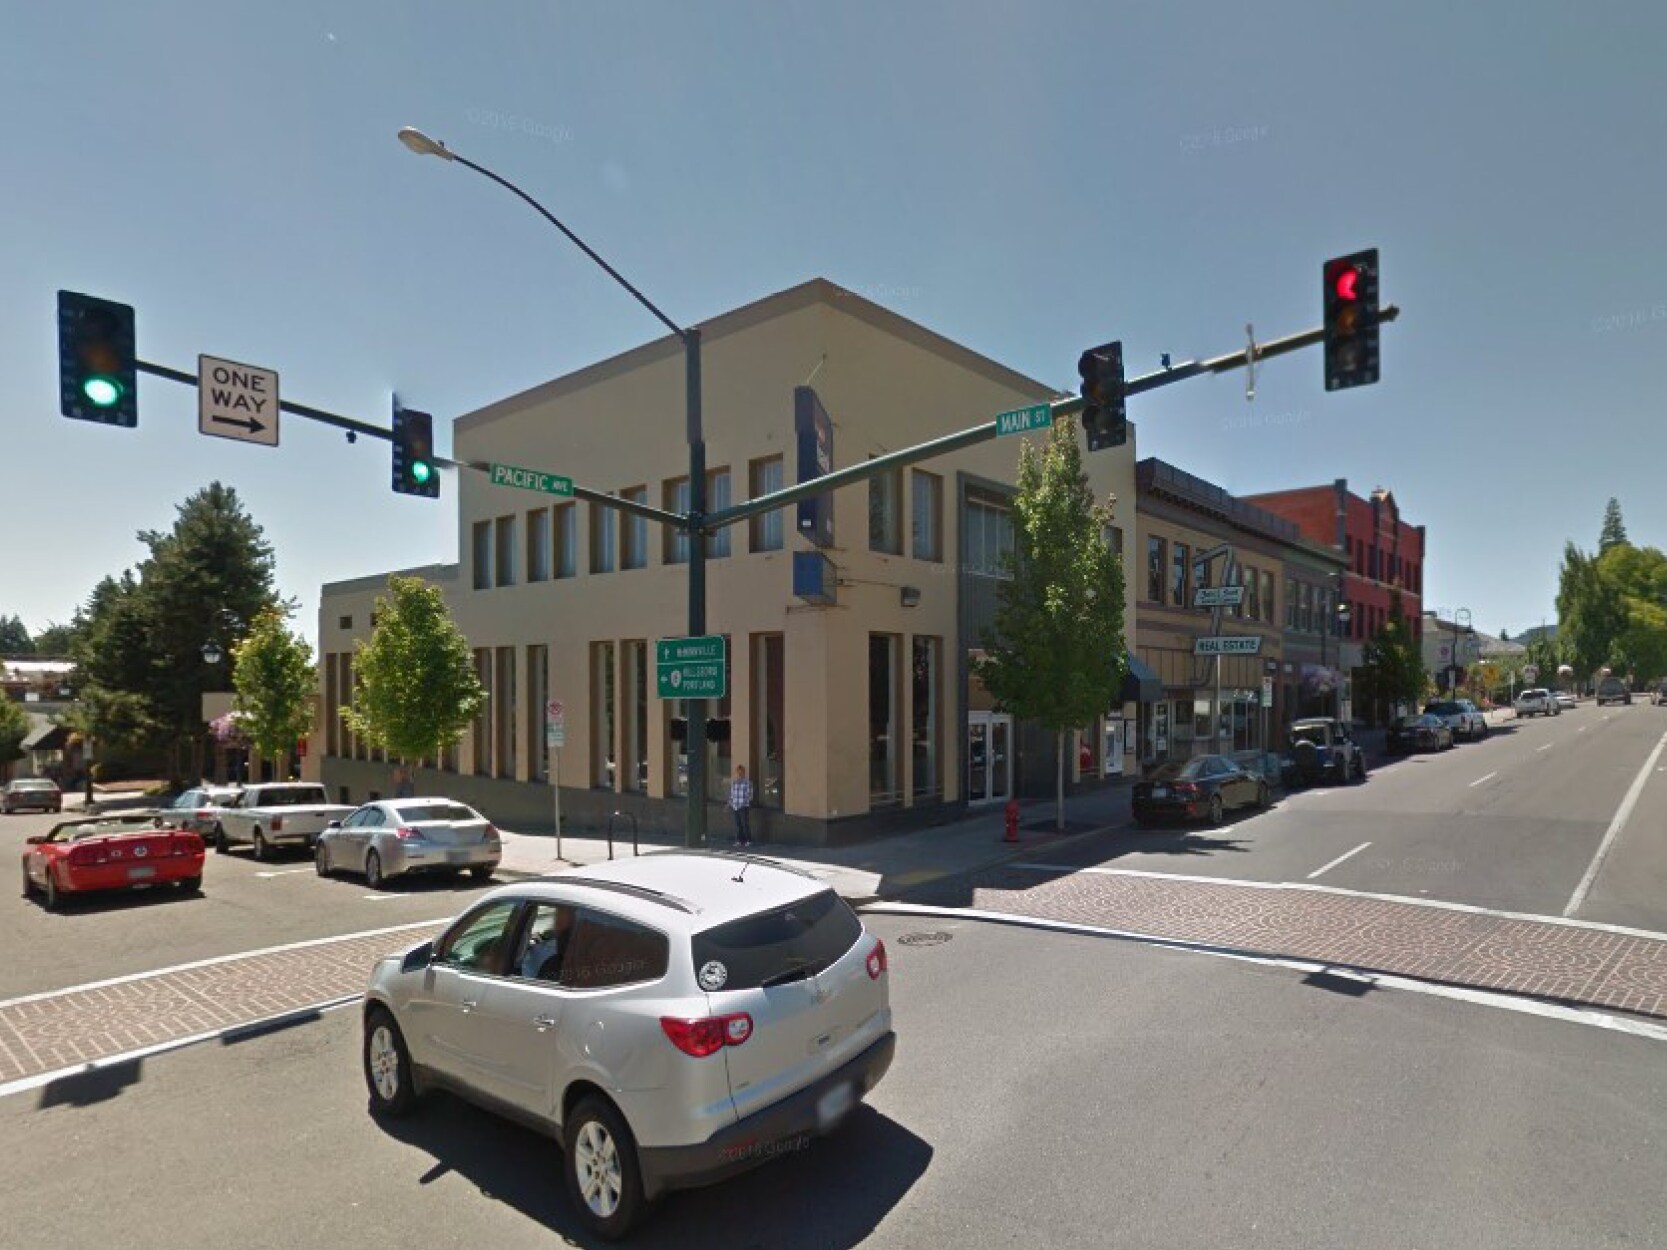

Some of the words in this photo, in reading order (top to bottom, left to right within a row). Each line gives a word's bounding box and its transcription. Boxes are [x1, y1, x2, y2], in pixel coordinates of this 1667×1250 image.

[213, 367, 266, 393] ONE
[211, 387, 266, 413] WAY
[1001, 410, 1031, 433] MAIN
[1035, 408, 1045, 424] ST
[495, 466, 549, 491] PACIFIC
[553, 480, 569, 492] AVE
[1198, 640, 1220, 652] REAL
[1223, 639, 1257, 651] ESTATE
